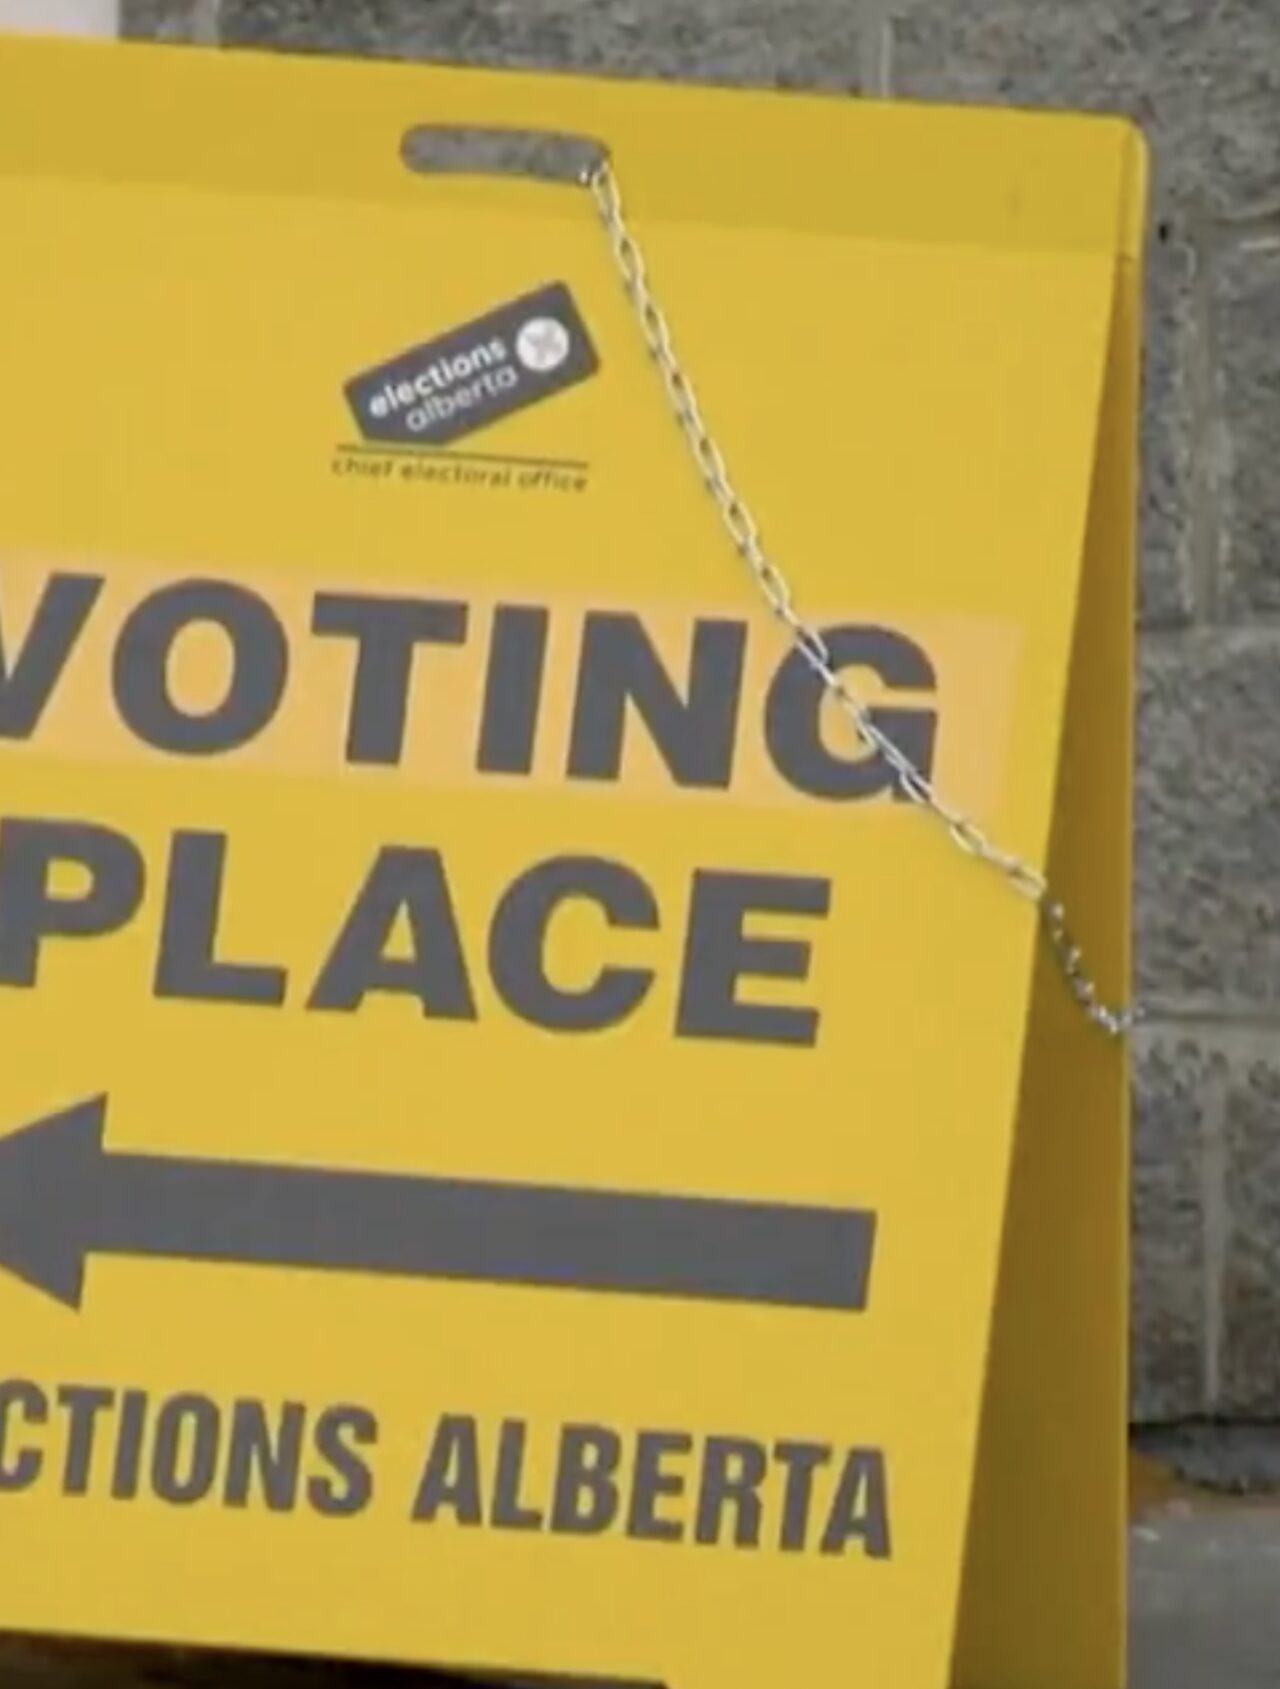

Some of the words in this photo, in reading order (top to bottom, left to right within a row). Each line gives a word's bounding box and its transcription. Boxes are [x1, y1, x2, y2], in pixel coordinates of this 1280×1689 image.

[369, 337, 508, 418] elections
[405, 364, 519, 432] alberta
[330, 457, 394, 478] chief
[400, 459, 511, 488] electoral
[517, 466, 589, 493] office
[410, 1412, 894, 1560] ALBERTA
